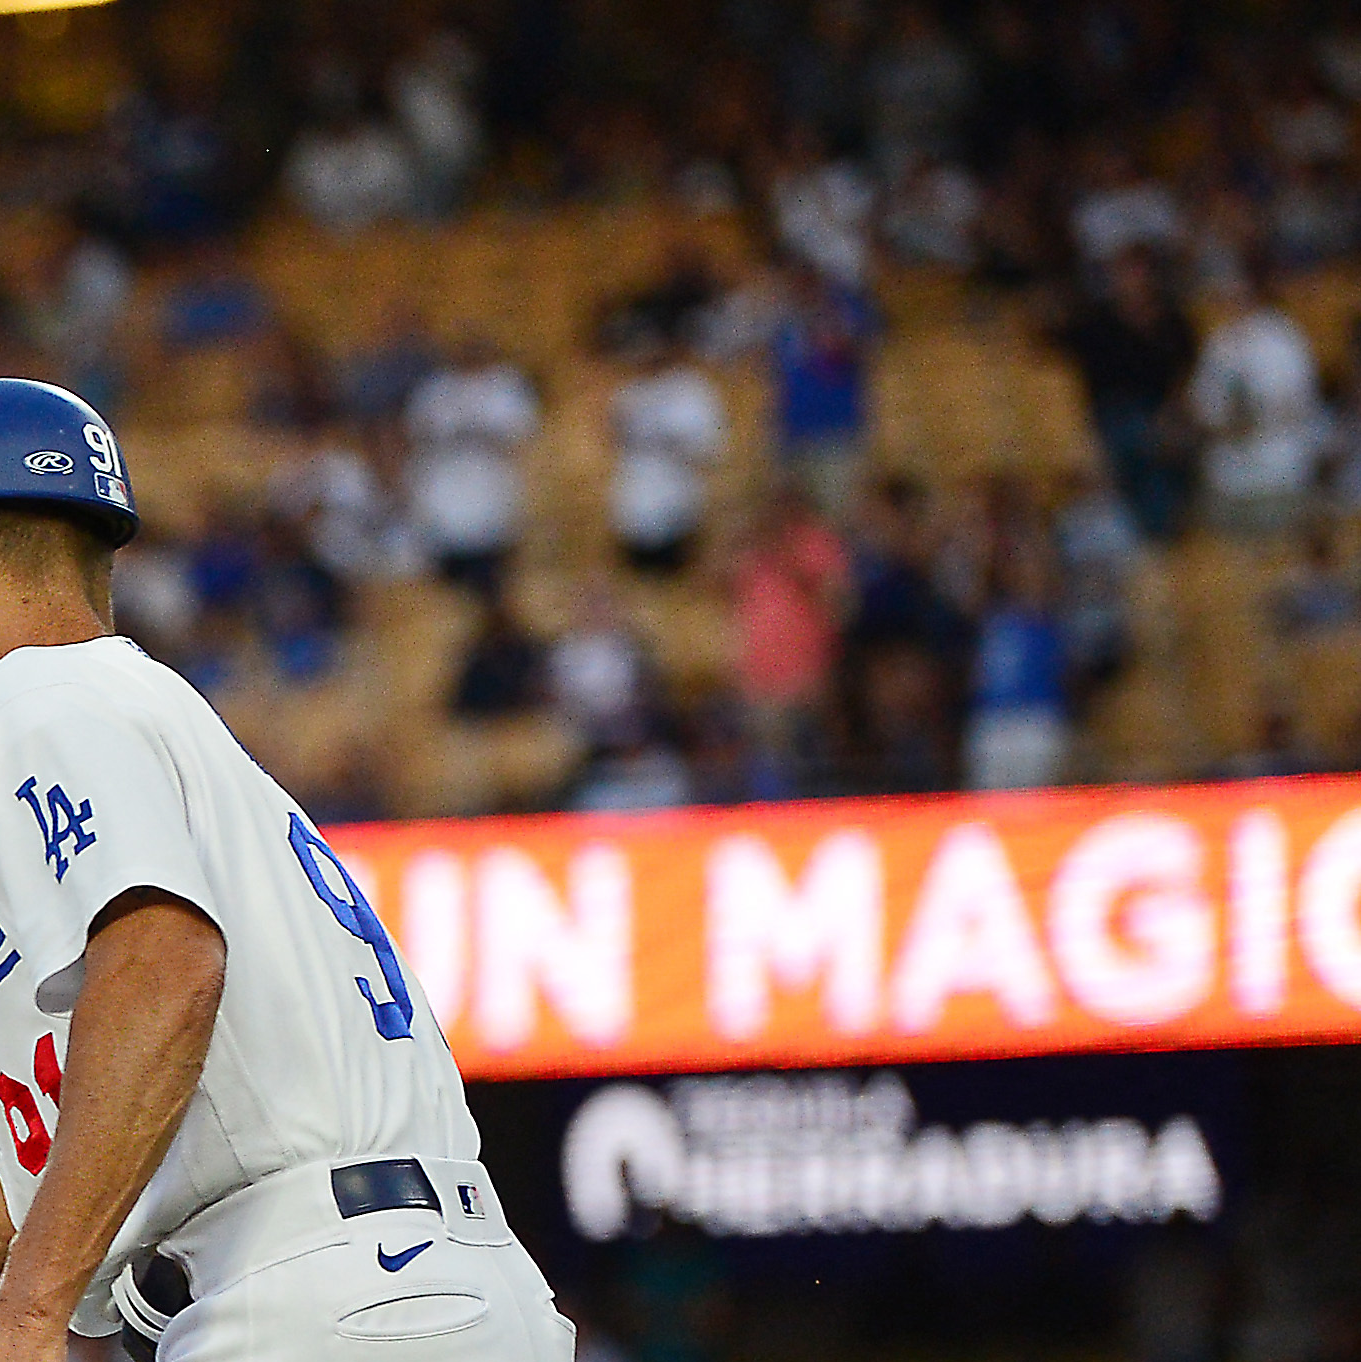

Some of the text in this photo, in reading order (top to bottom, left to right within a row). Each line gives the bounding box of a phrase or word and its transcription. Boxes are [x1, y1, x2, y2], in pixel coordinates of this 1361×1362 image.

[83, 424, 122, 478] 91
[14, 775, 97, 884] LA
[287, 812, 414, 1041] 9
[340, 838, 633, 1056] UN
